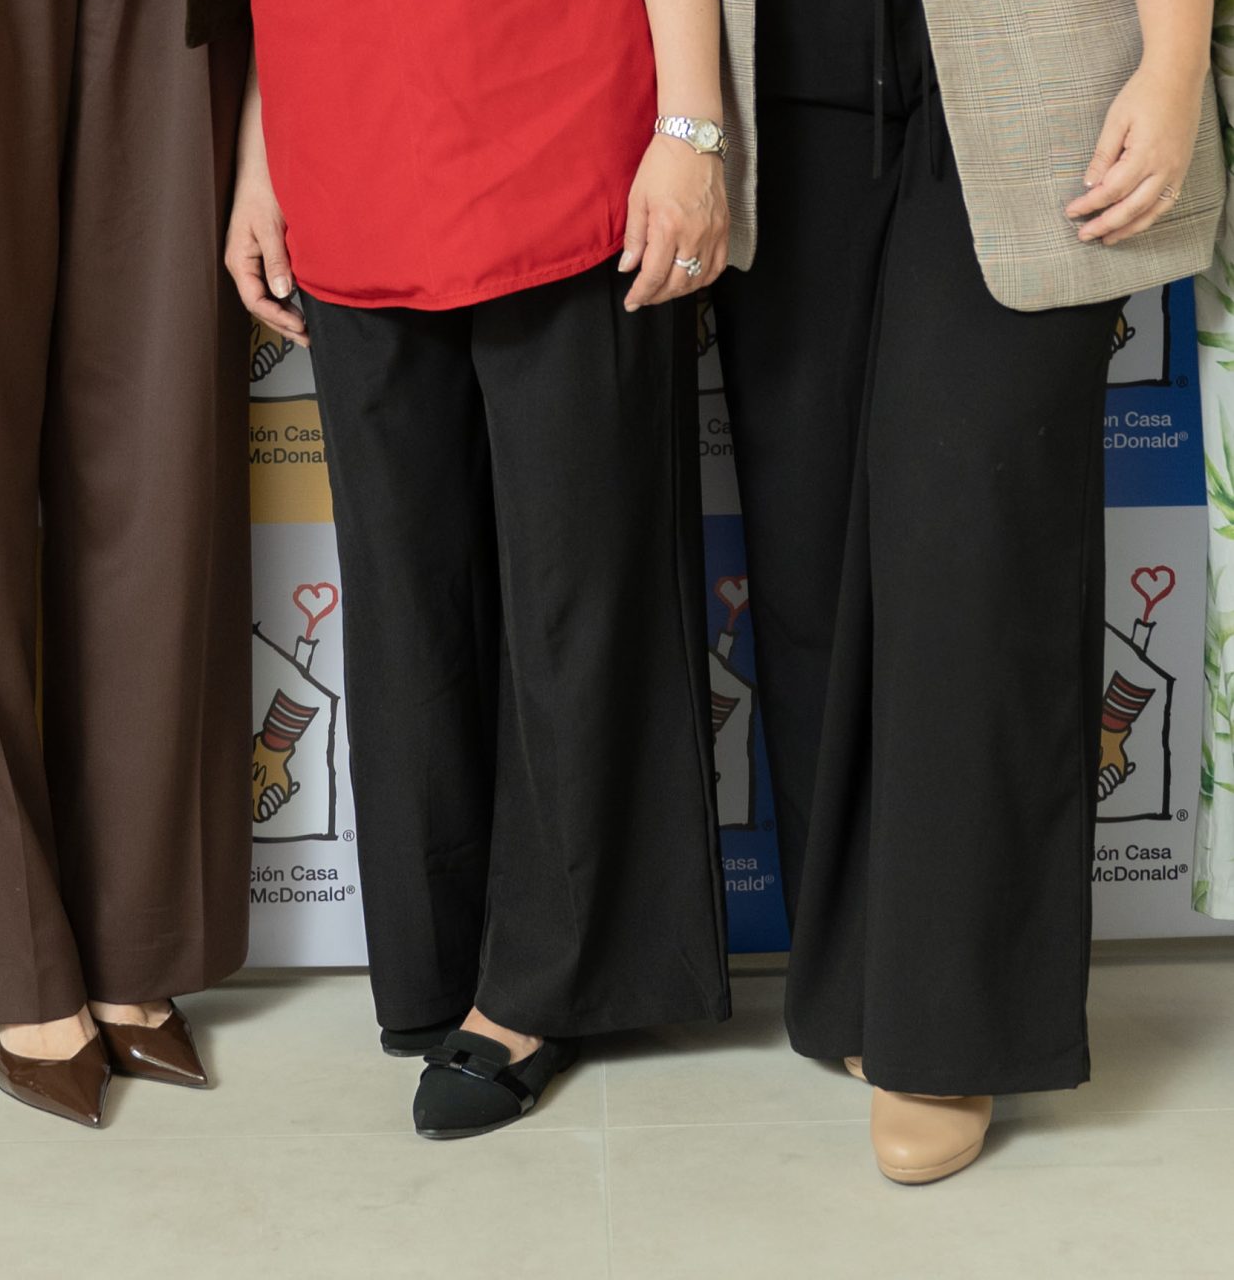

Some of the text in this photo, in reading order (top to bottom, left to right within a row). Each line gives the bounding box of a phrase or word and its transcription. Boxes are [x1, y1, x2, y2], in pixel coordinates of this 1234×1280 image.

[1125, 411, 1172, 427] Casa
[284, 425, 323, 442] Cas
[1103, 431, 1189, 449] cDonald®
[1125, 844, 1172, 860] Casa
[722, 856, 758, 871] asa
[291, 865, 339, 881] Casa
